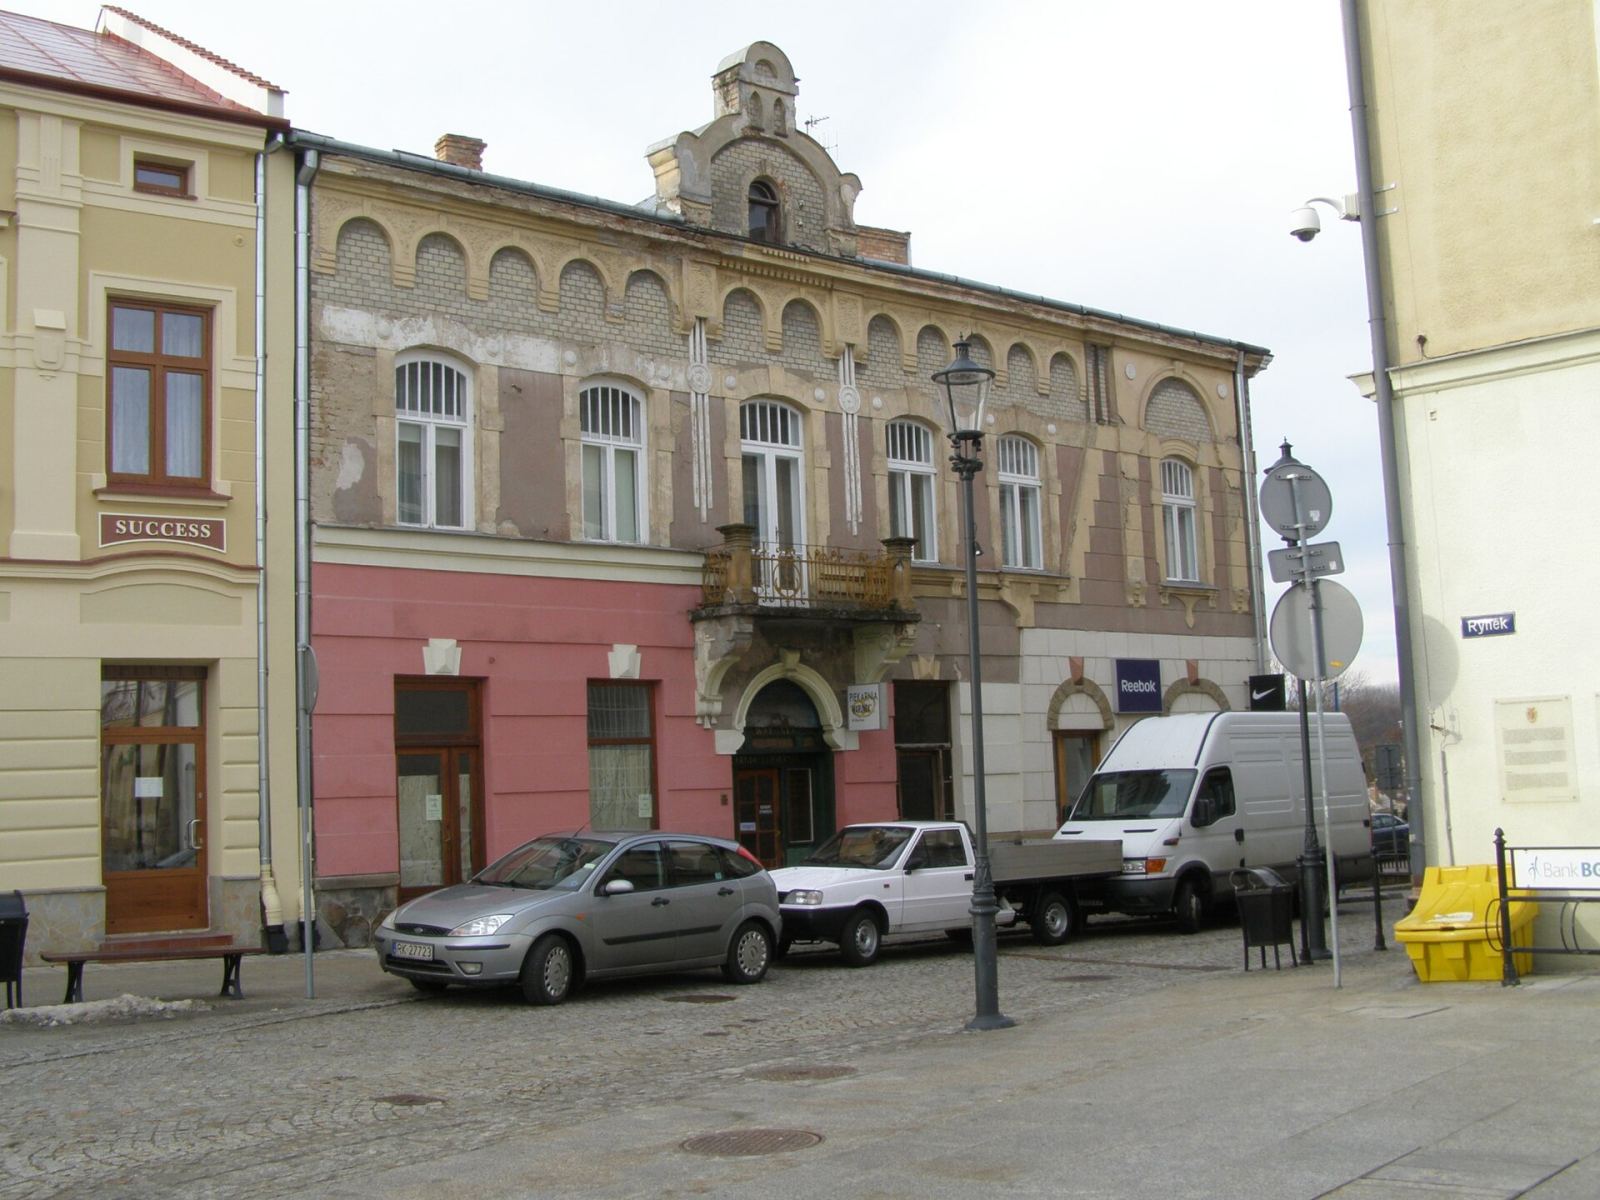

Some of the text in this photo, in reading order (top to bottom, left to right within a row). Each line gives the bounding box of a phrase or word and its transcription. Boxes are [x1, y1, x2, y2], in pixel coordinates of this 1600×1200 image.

[115, 520, 211, 538] SUCCESS
[1467, 616, 1508, 635] Rynek
[1121, 680, 1156, 692] Reebok
[1543, 861, 1578, 878] Bank
